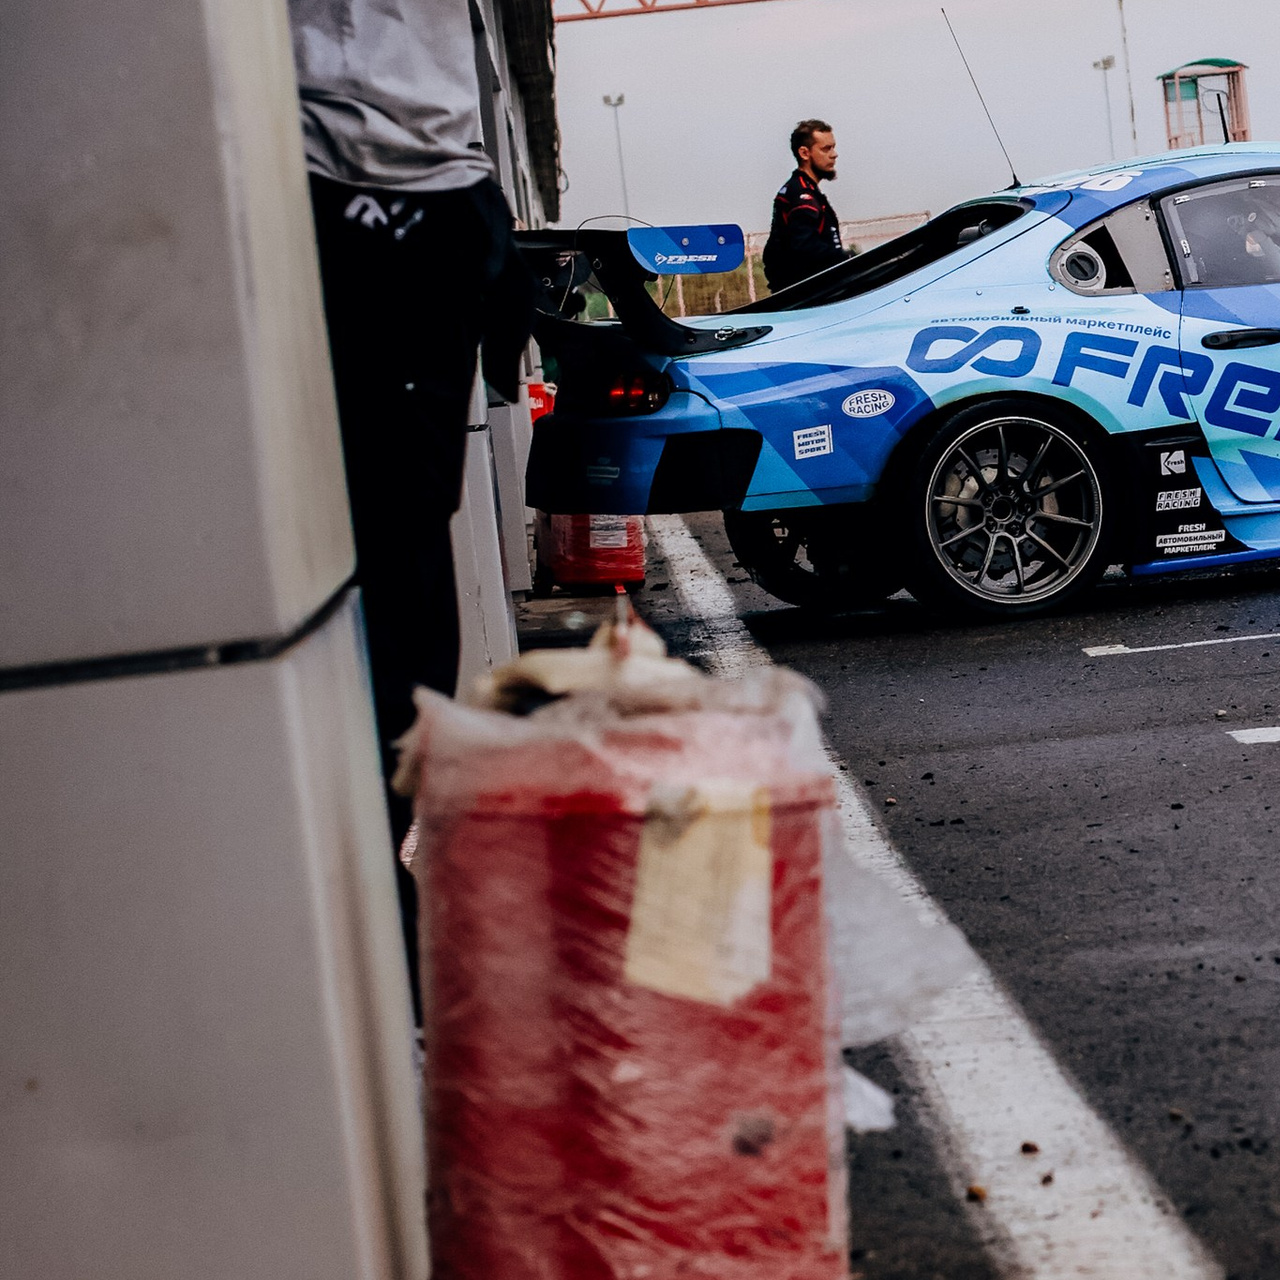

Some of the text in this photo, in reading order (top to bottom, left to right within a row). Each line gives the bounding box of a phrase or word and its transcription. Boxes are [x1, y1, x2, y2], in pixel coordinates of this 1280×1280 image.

[931, 315, 1172, 339] автомобильный маркетплейс
[849, 393, 887, 406] FRESH
[849, 401, 890, 414] RACING
[797, 430, 826, 440] FRESH
[798, 438, 826, 447] MOTOR
[798, 445, 827, 455] SPORT
[1158, 489, 1196, 500] FRESH
[1157, 499, 1200, 510] RACING
[1178, 523, 1206, 533] FRESH
